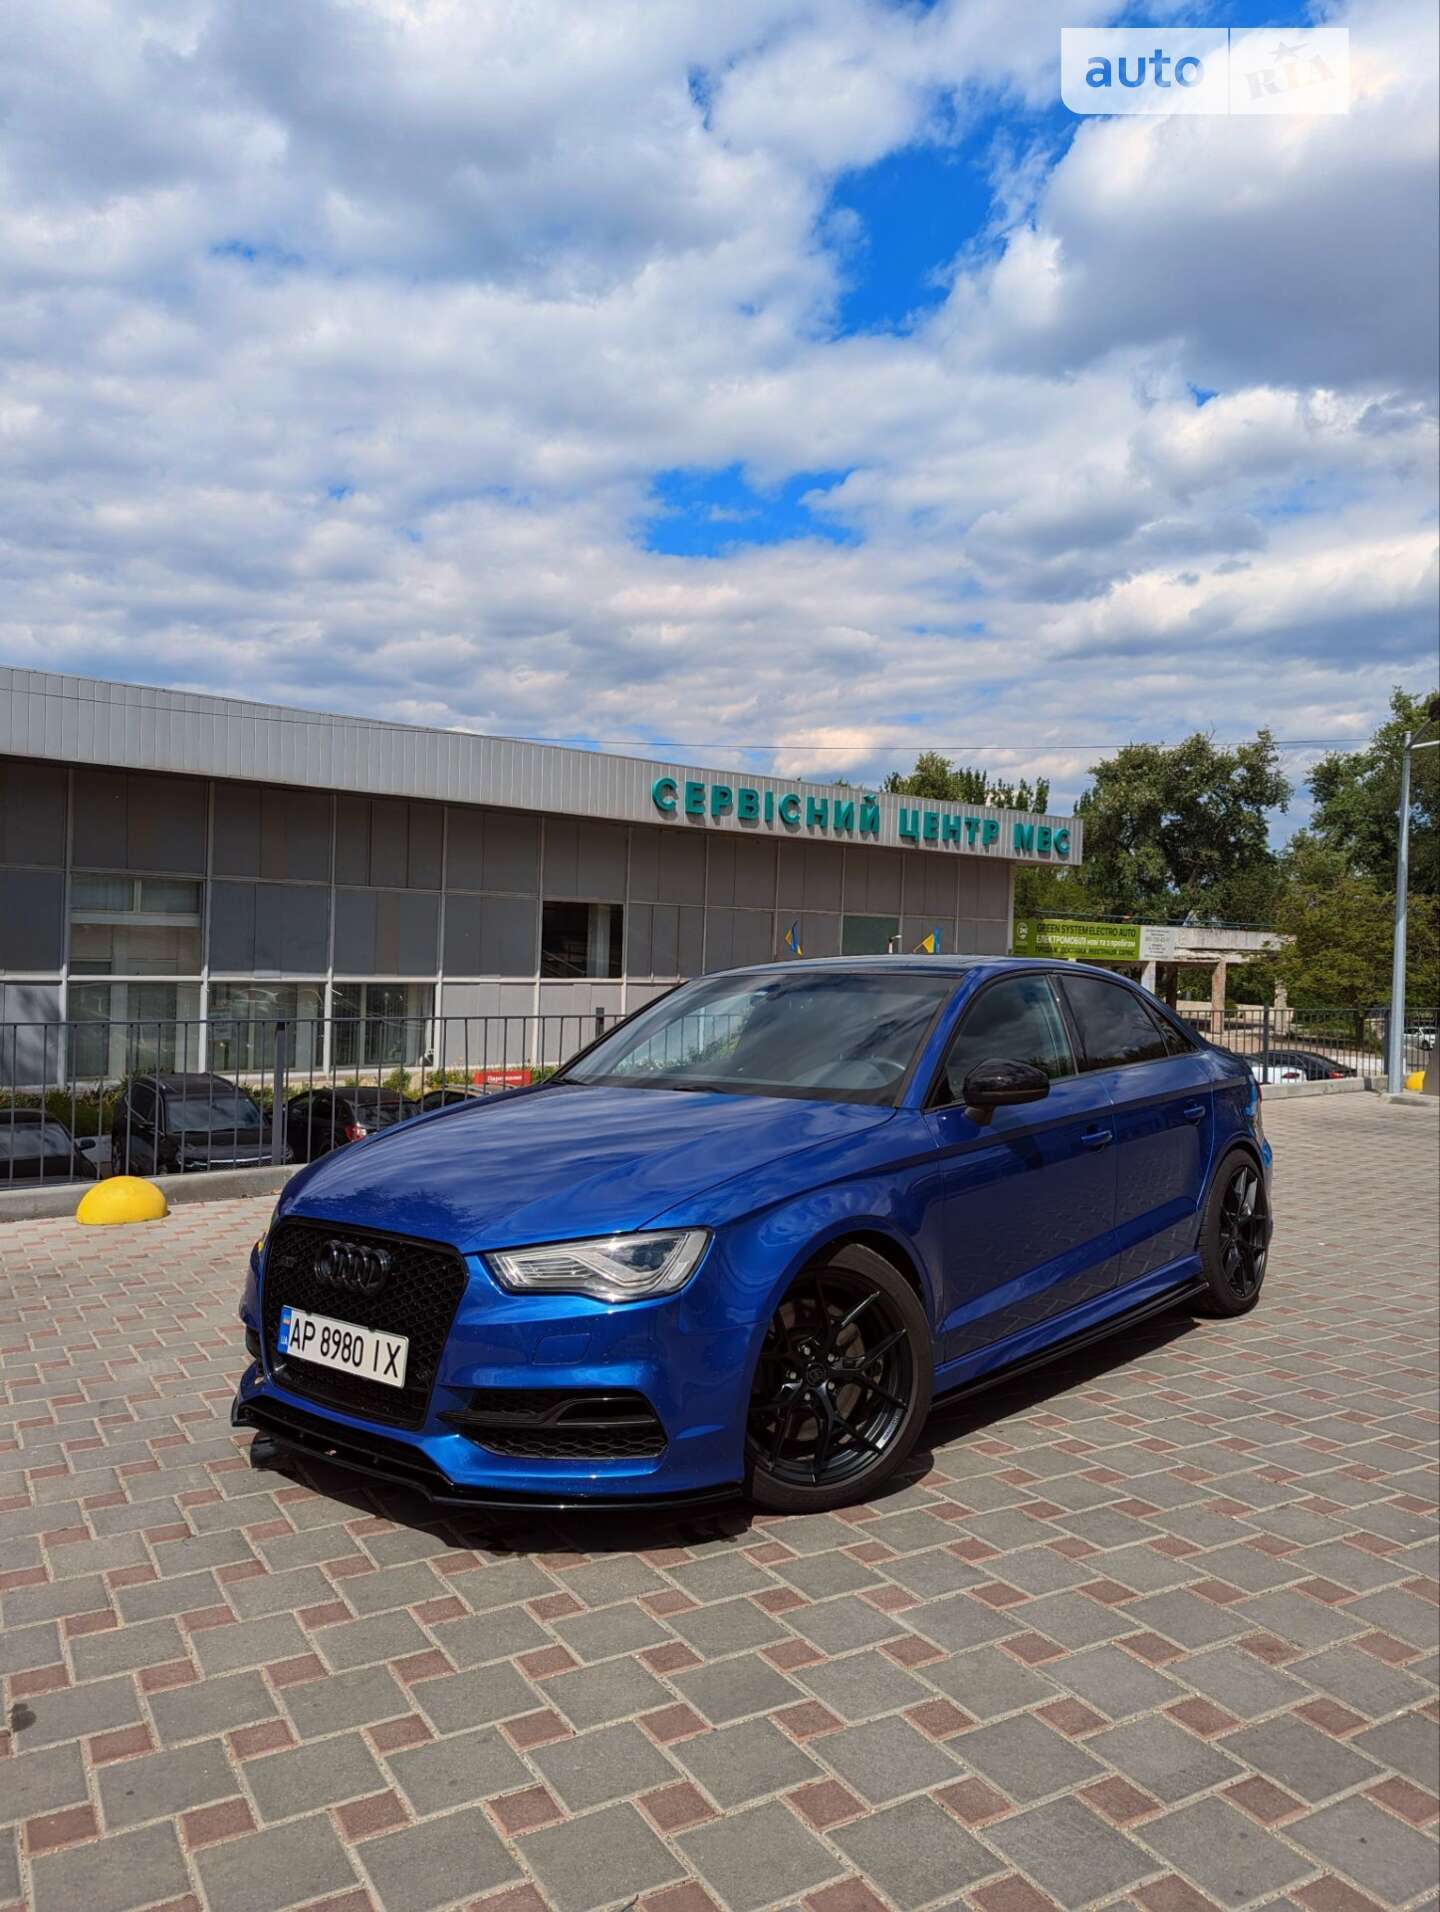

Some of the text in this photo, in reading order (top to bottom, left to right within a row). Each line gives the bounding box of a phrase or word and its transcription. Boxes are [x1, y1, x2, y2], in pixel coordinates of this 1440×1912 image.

[652, 777, 1071, 856] СЕРВІСНИЙ ЦЕНТР МВС
[1062, 924, 1088, 935] SYSTEM
[1089, 926, 1118, 936] ELECTRO
[1120, 928, 1136, 937] AUTO
[290, 1318, 316, 1352] AP
[320, 1326, 364, 1367] 8980
